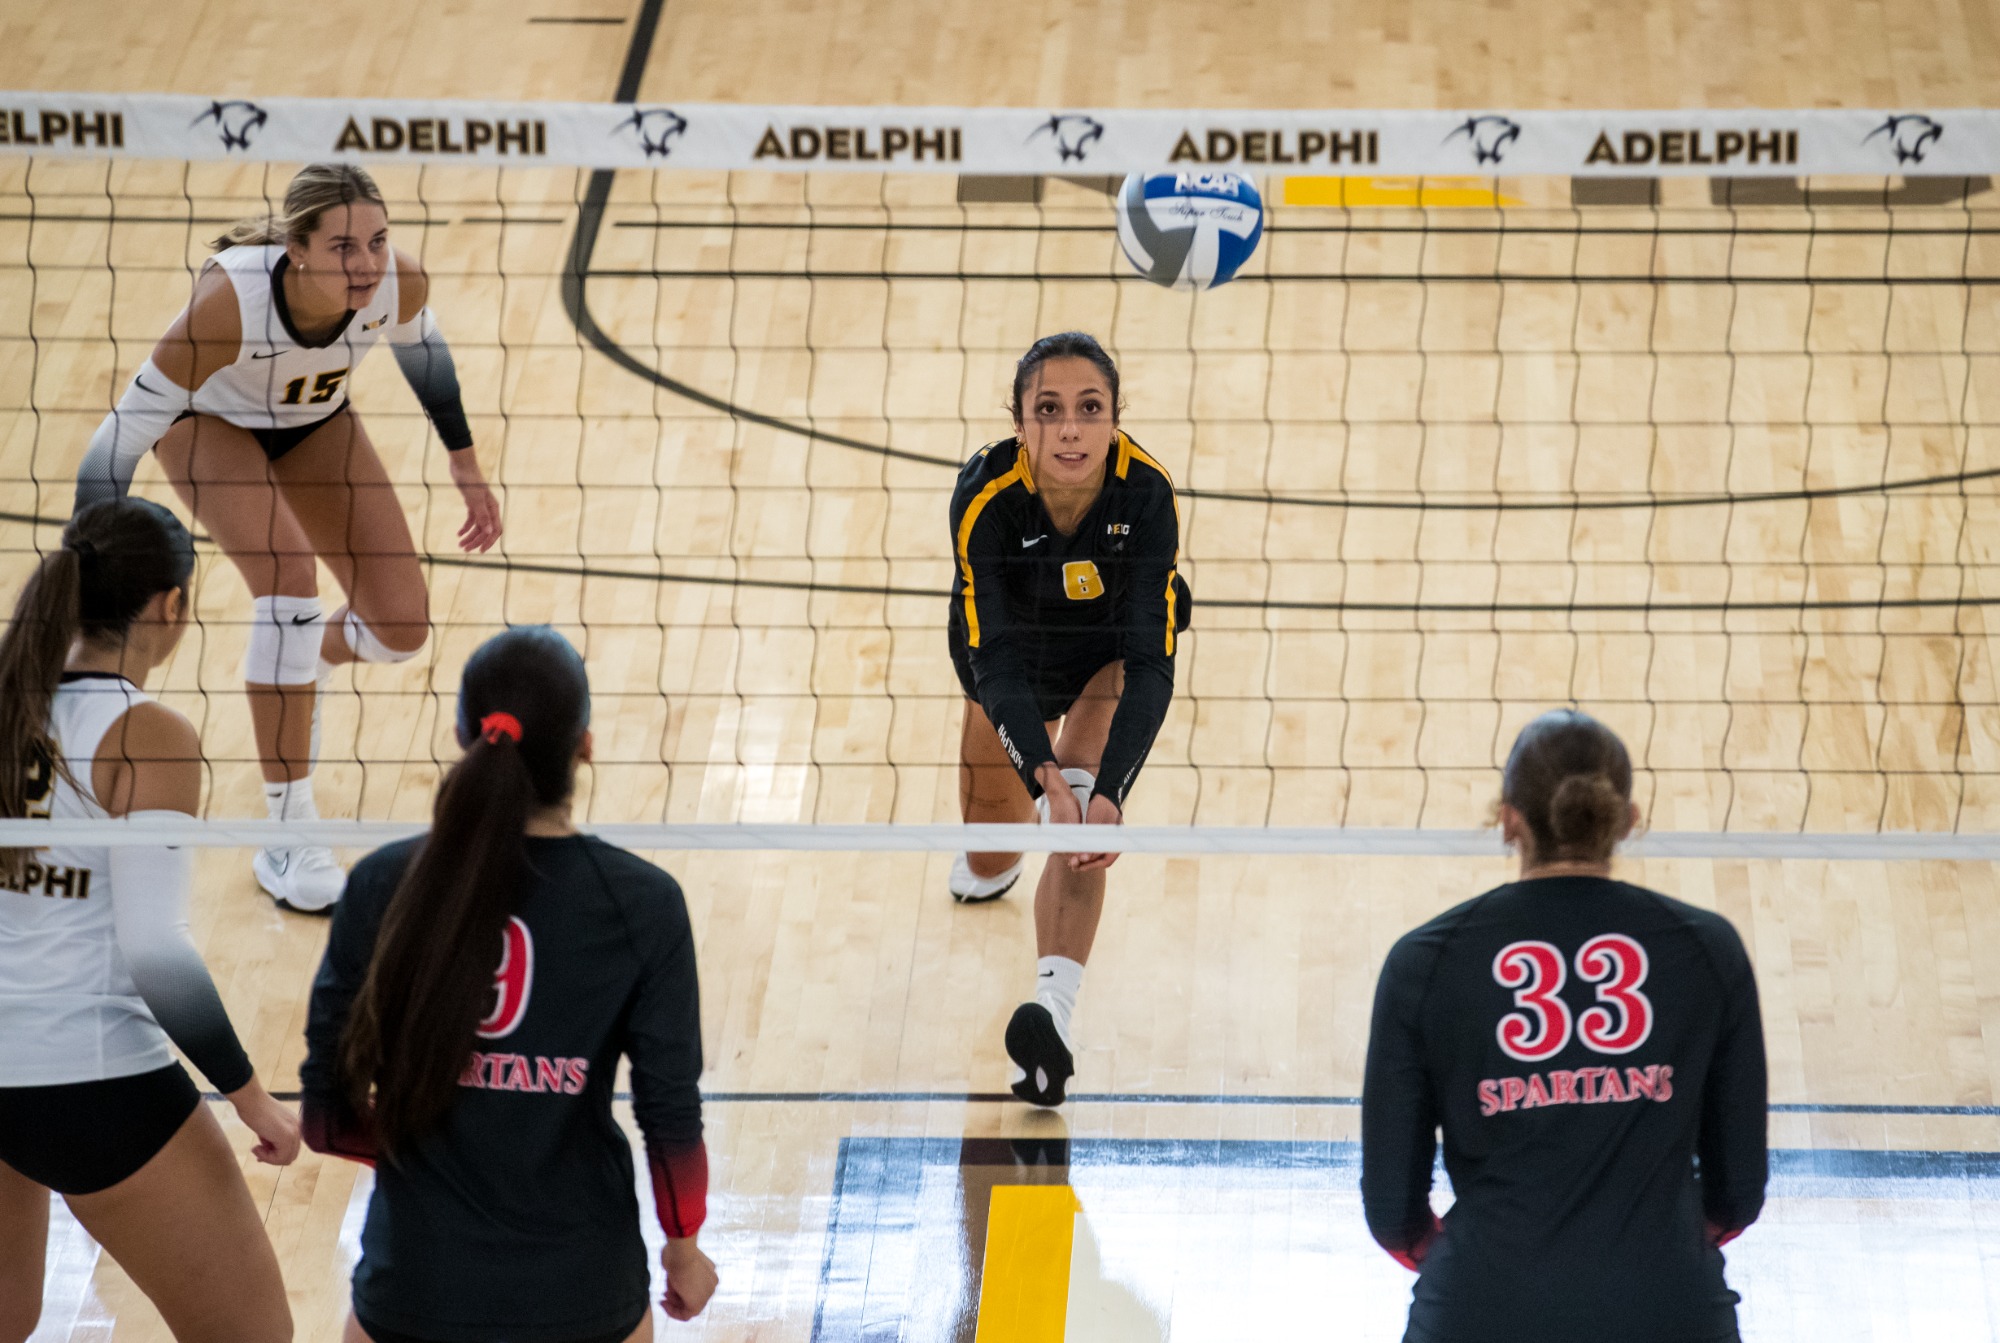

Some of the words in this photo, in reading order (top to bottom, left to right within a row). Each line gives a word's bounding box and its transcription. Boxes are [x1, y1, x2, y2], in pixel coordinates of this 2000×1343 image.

[335, 117, 547, 157] ADELPHI
[753, 126, 963, 162] ADELPHI
[1168, 129, 1379, 164] ADELPHI
[1585, 129, 1799, 165] ADELPHI
[1174, 173, 1240, 197] NCAA
[279, 367, 349, 405] 15
[0, 863, 91, 900] LPHI
[1492, 933, 1654, 1063] 33
[457, 1051, 590, 1096] RTANS
[1477, 1064, 1673, 1116] SPARTANS
